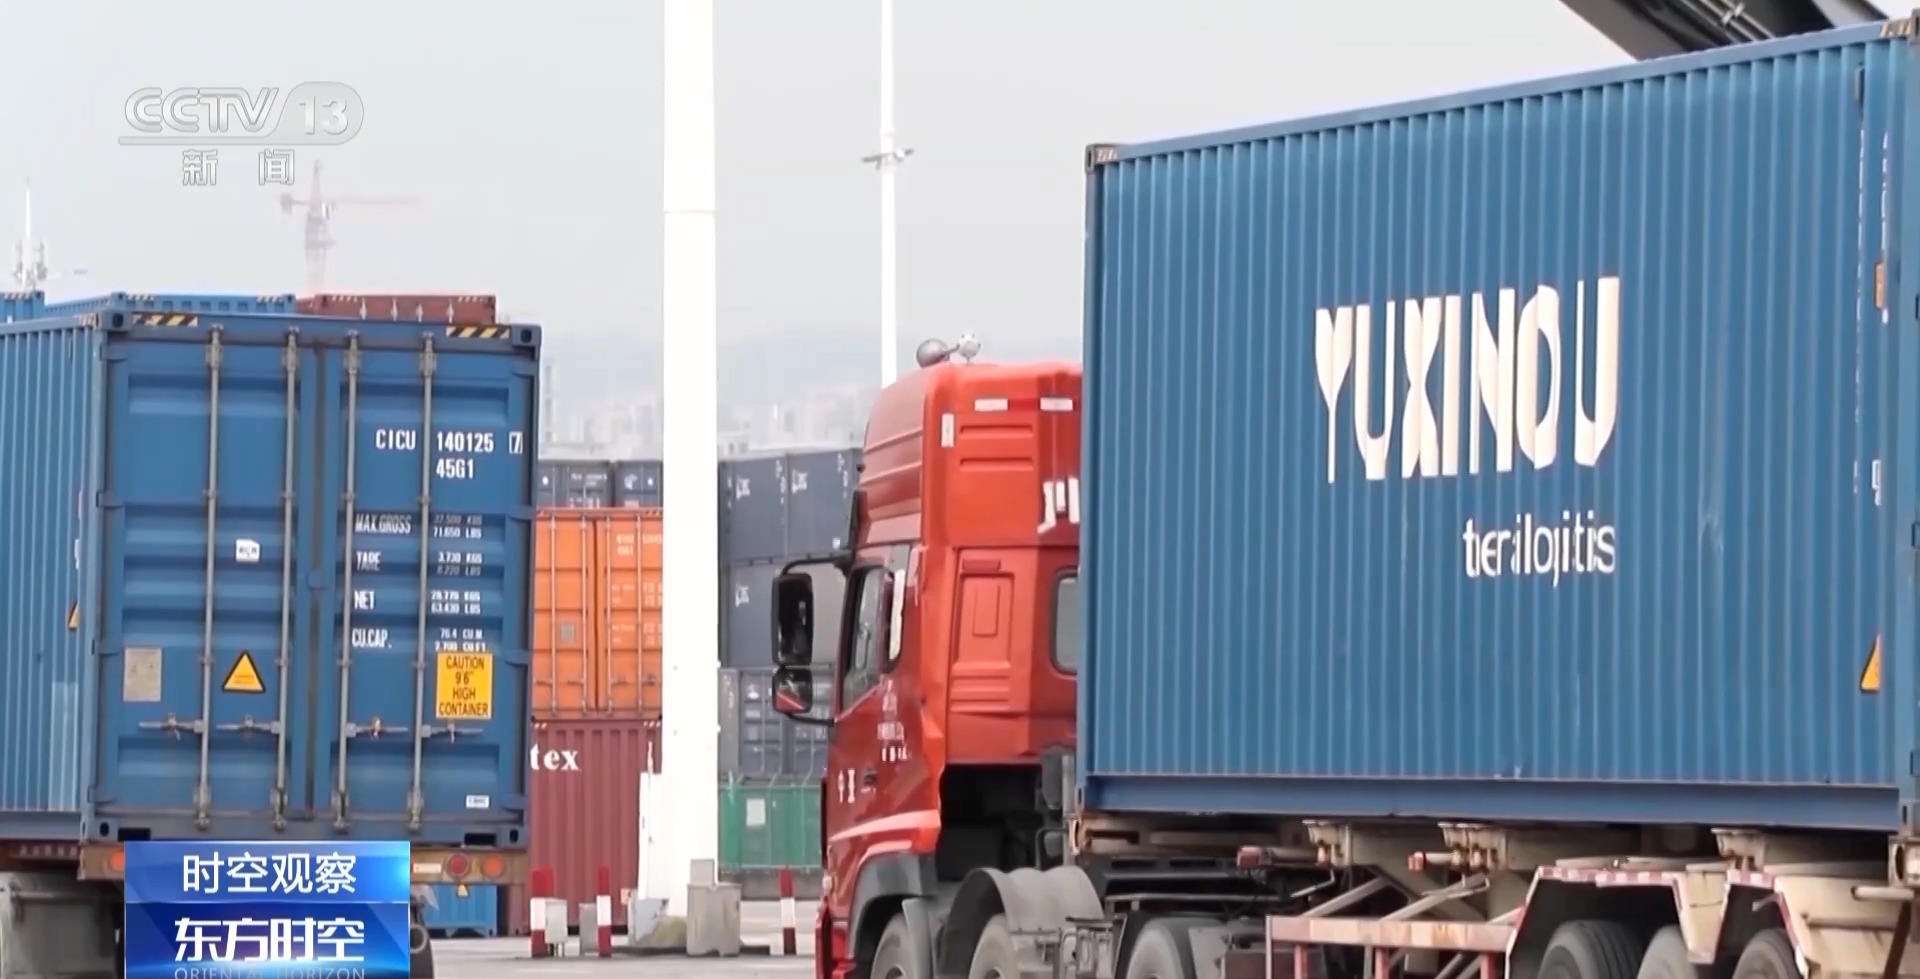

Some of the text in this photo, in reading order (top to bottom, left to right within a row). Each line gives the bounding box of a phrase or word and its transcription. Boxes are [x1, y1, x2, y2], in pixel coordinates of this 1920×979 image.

[1315, 276, 1620, 484] YUXINOU
[376, 429, 416, 450] CICU
[437, 431, 494, 453] 140125
[436, 458, 474, 479] 45G1
[356, 551, 381, 571] TARE
[354, 590, 375, 610] NET
[446, 656, 484, 670] CAUTION
[452, 687, 476, 700] HIGH
[439, 701, 488, 716] CONTAINER
